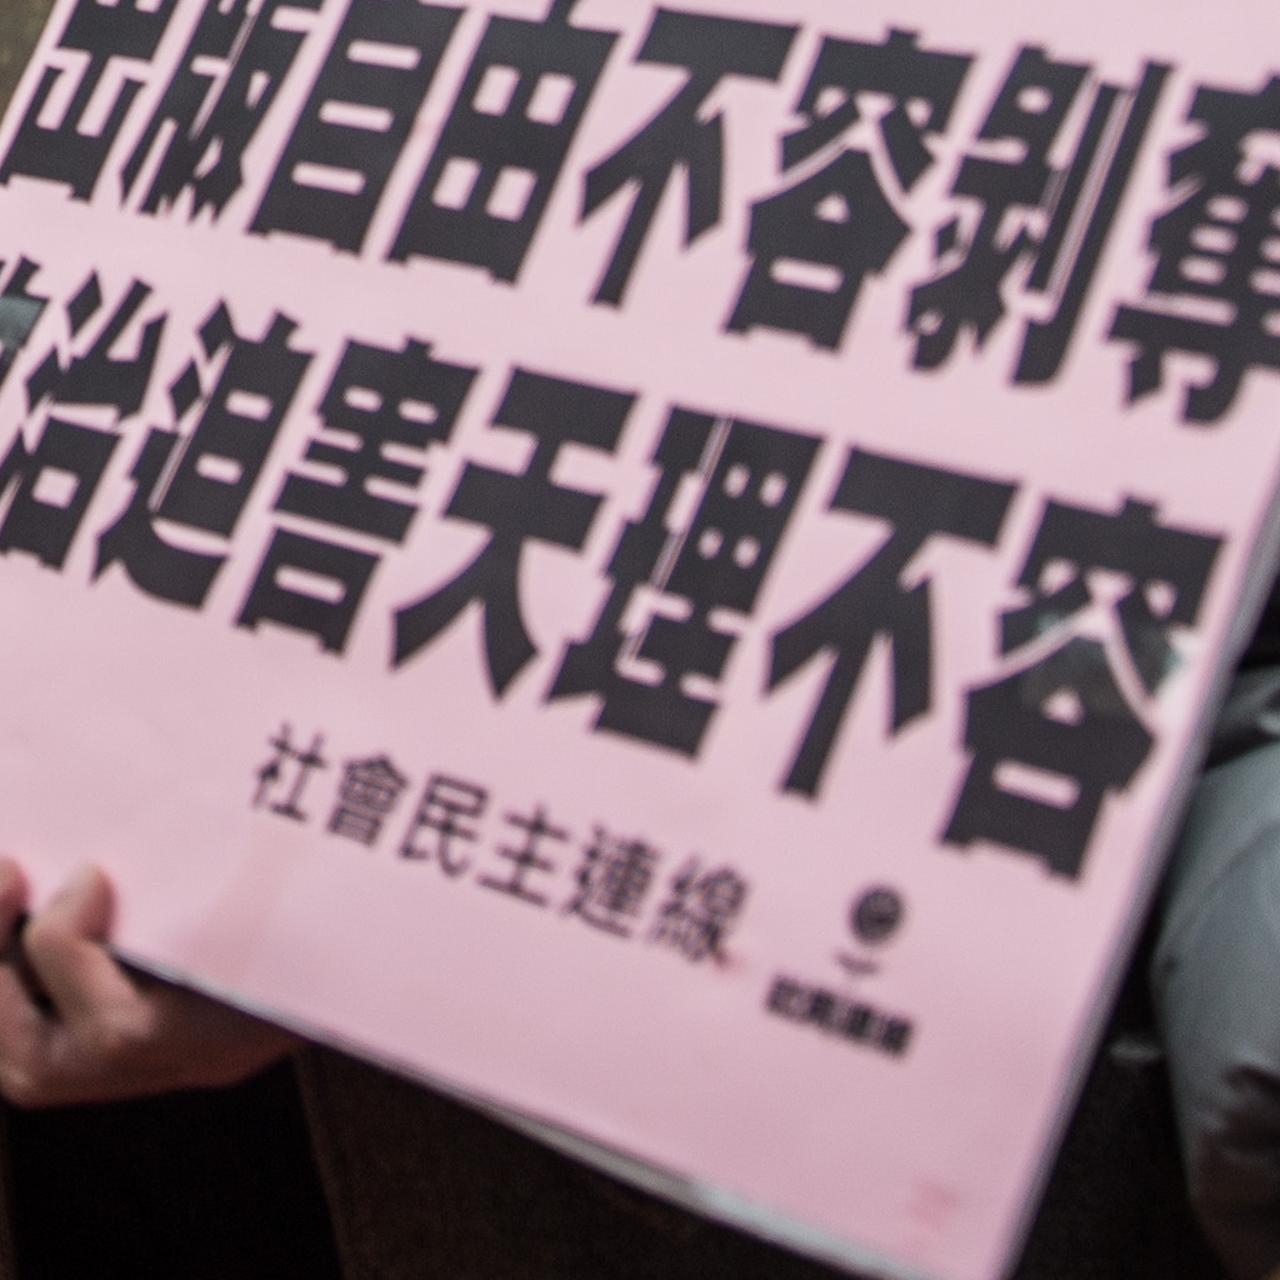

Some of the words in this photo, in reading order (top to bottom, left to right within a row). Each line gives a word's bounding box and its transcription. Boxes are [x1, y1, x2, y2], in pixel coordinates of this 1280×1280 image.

[252, 722, 752, 970] 社會民主連線
